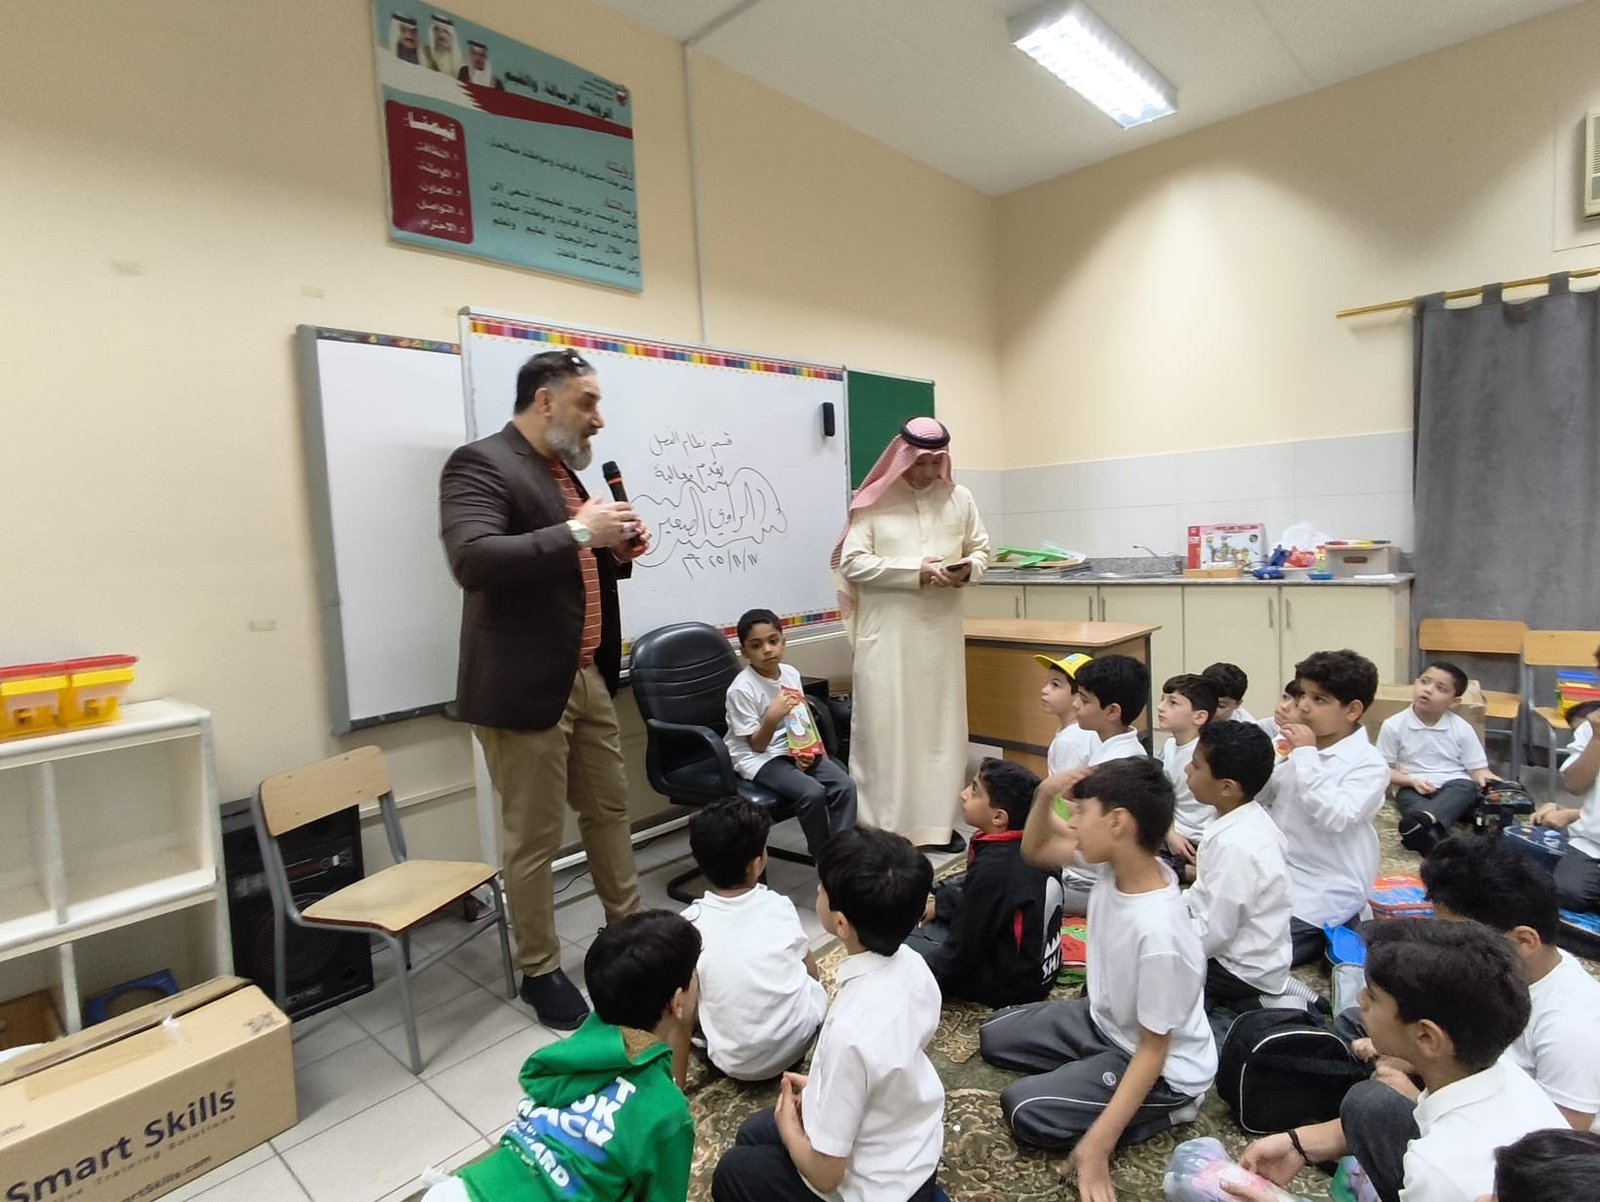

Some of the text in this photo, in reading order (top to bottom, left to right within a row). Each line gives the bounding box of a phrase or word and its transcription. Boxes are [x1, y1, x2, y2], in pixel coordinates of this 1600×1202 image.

[682, 431, 706, 458] نظام
[711, 432, 733, 460] قسم
[5, 1089, 236, 1202] Smart Skills
